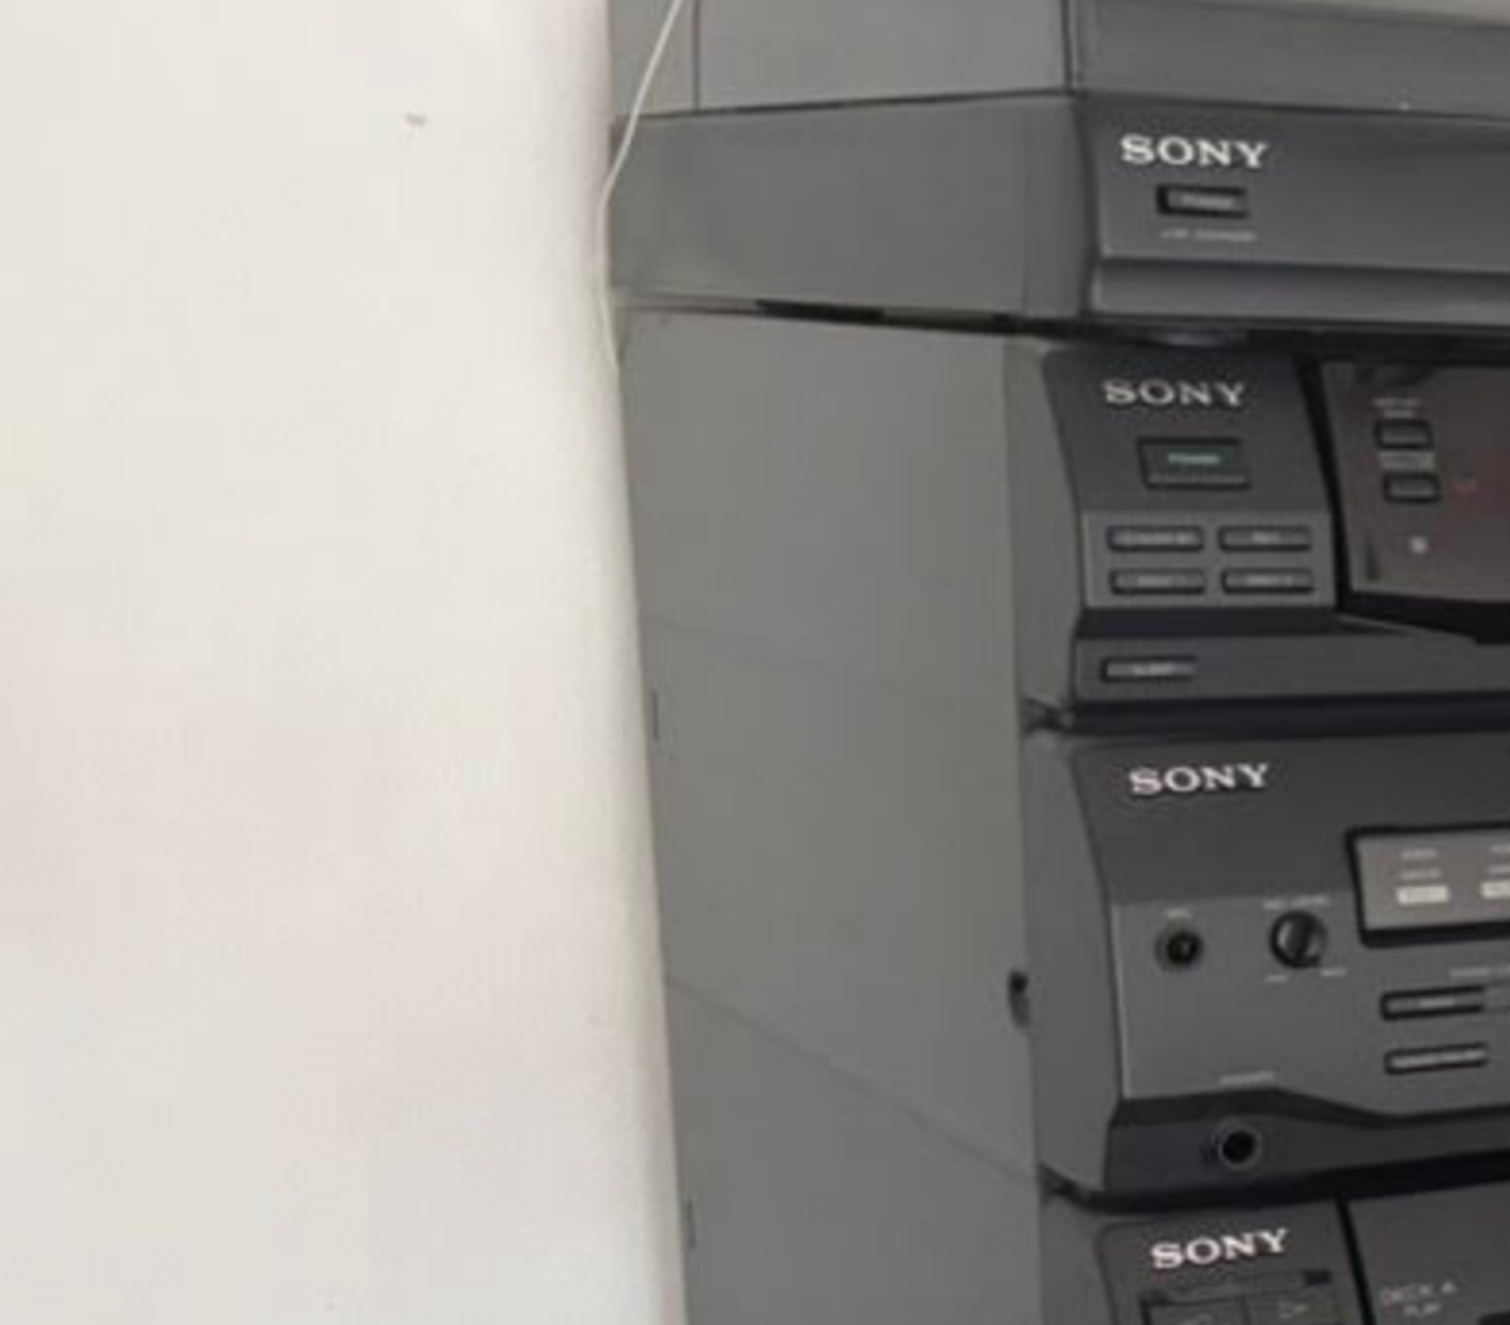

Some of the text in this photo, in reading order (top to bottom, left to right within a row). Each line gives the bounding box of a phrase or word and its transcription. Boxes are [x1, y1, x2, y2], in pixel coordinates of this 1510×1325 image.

[1120, 134, 1269, 168] SONY
[1103, 378, 1245, 408] SONY
[1129, 763, 1268, 795] SONY
[1149, 1227, 1288, 1269] SONY
